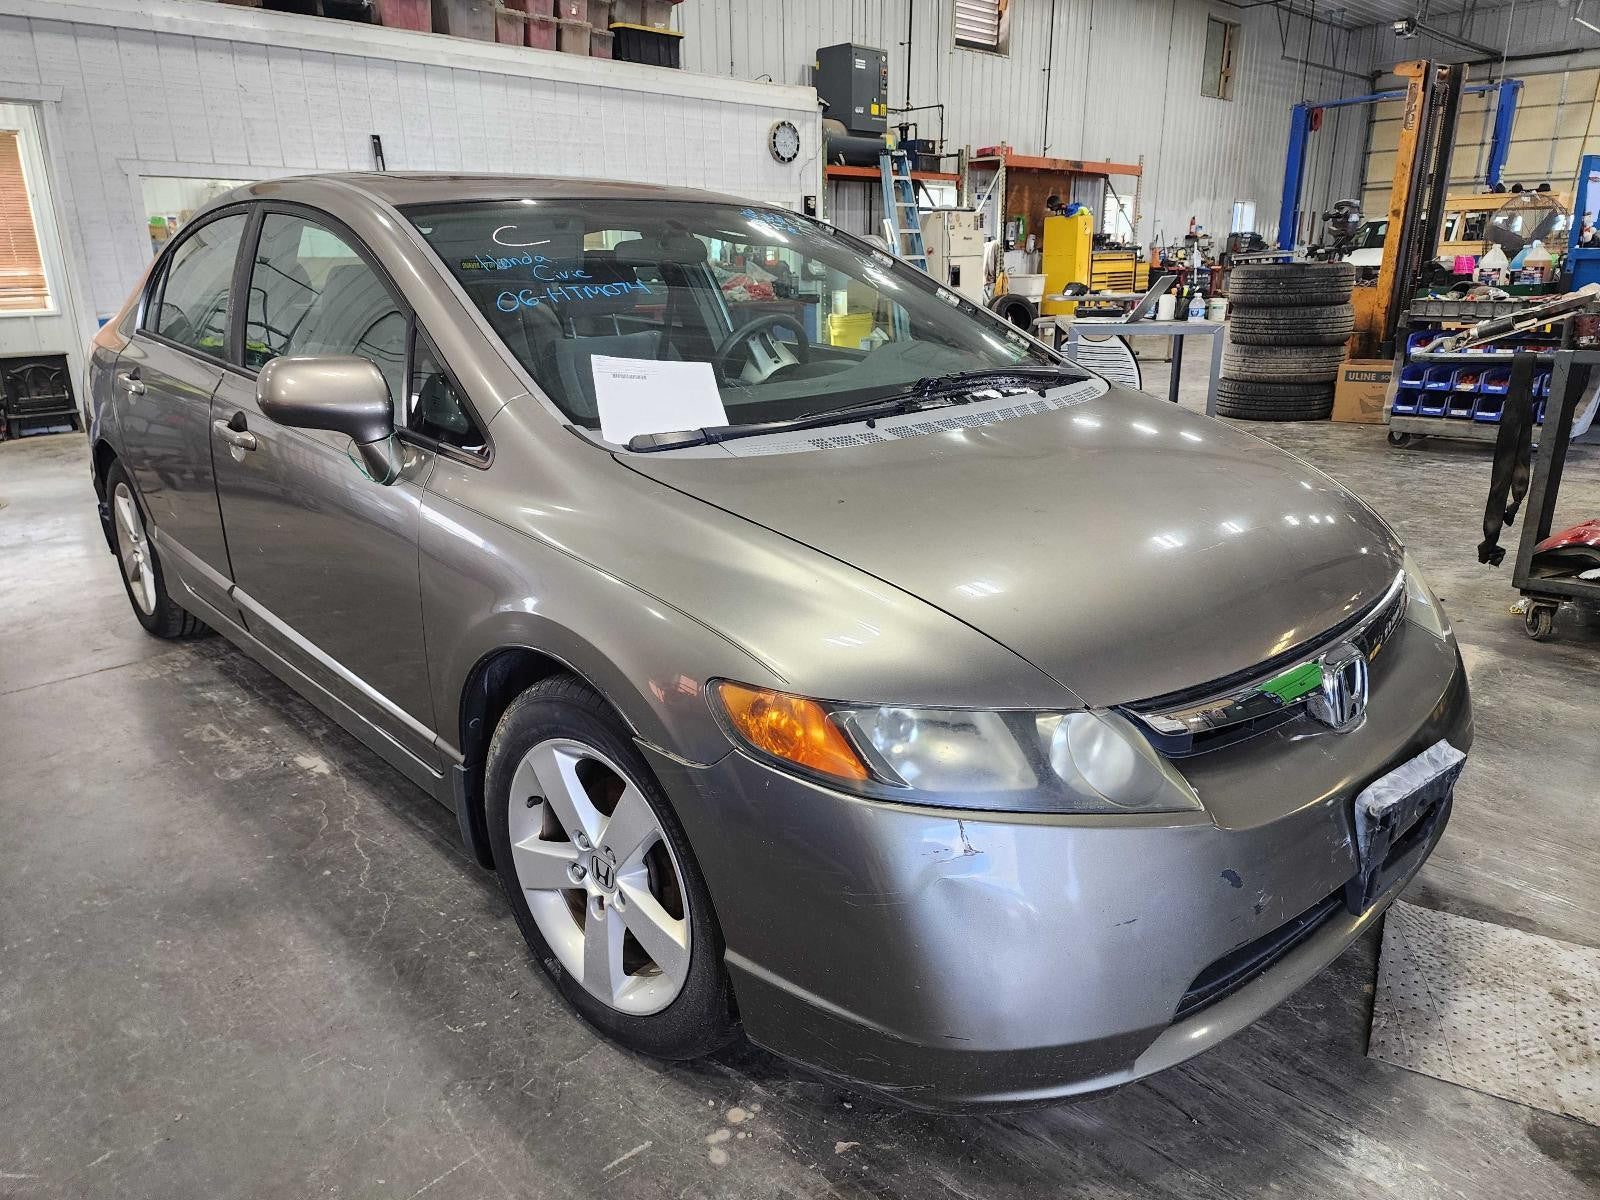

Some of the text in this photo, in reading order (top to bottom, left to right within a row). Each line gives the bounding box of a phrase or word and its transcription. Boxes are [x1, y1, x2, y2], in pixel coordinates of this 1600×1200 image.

[475, 251, 552, 272] Honda
[533, 265, 593, 281] Civic
[1348, 372, 1377, 381] ULINE
